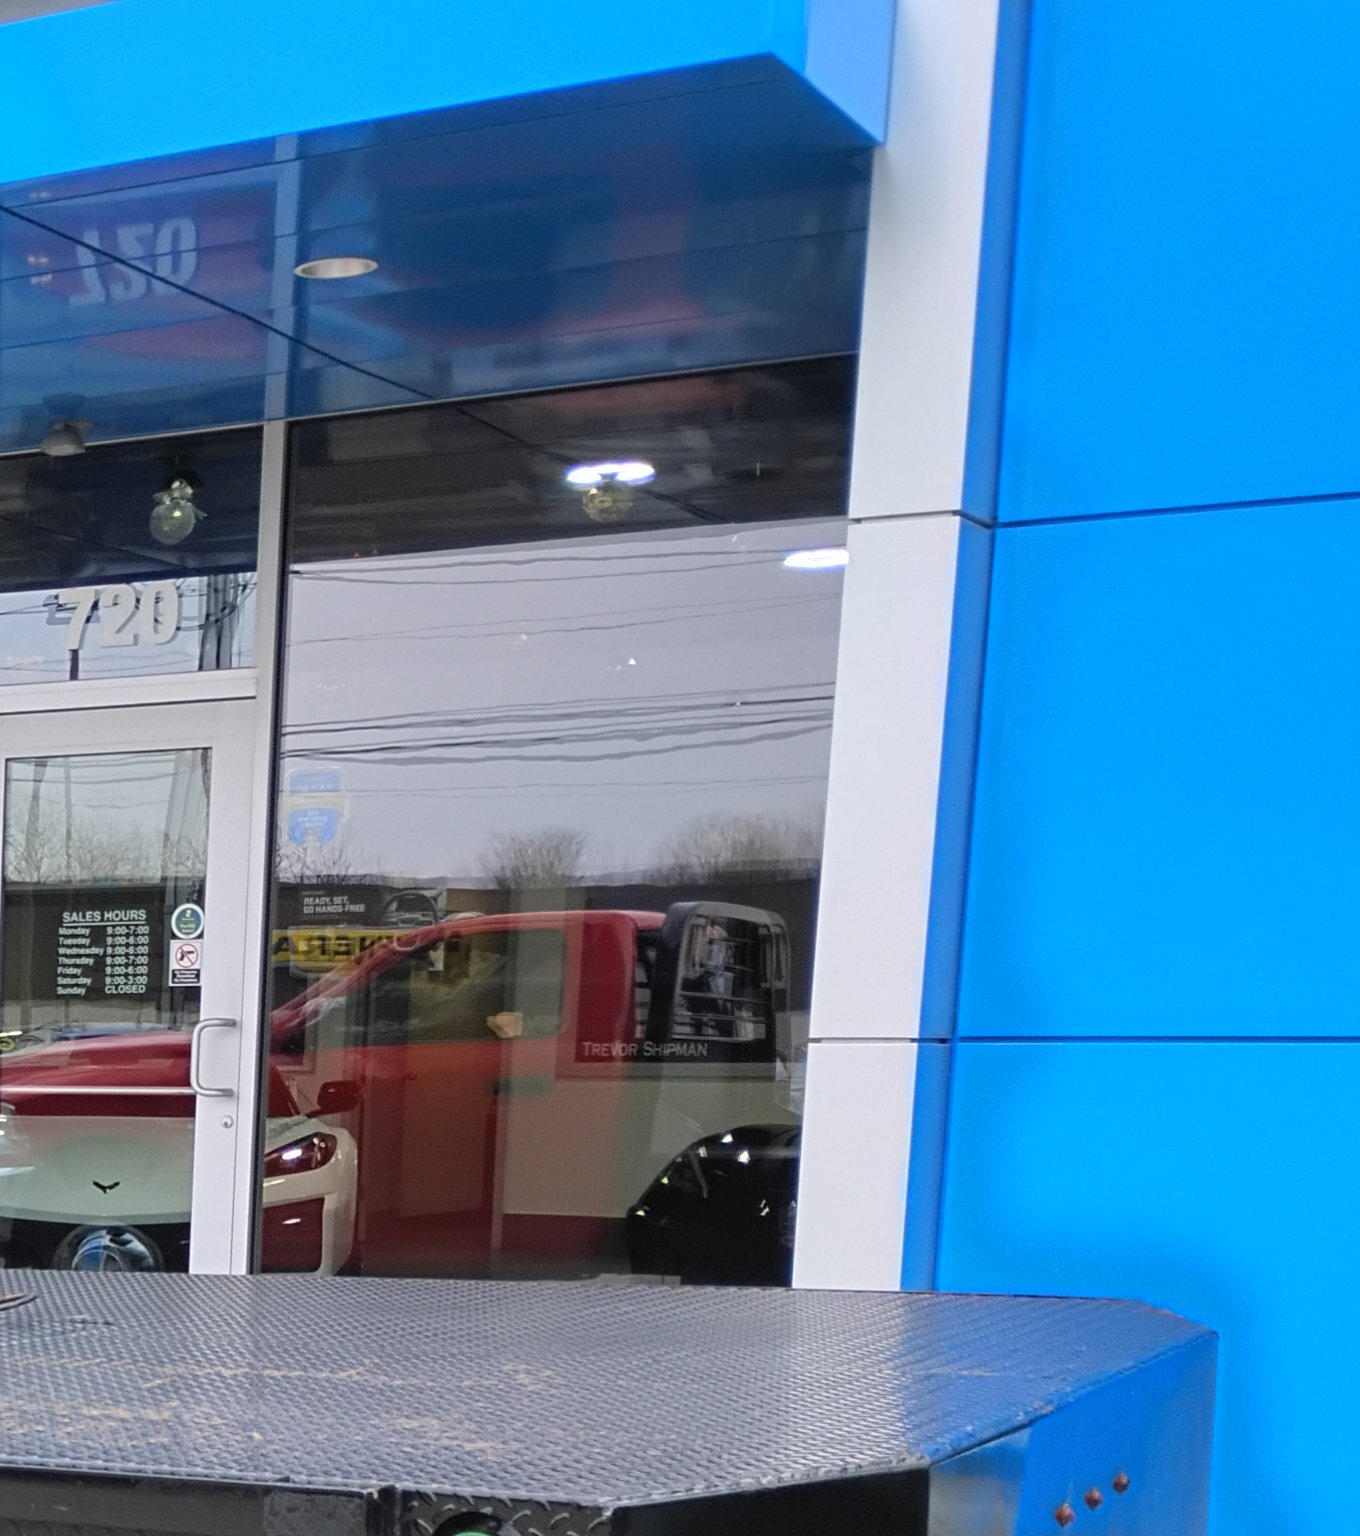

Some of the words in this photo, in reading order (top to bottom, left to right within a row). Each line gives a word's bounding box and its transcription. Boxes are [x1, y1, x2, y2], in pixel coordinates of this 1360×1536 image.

[57, 581, 179, 651] 720
[62, 911, 101, 923] SALES
[104, 909, 147, 922] HOURS
[58, 927, 90, 936] Monday
[106, 926, 149, 935] 9:00-7:00
[58, 937, 90, 946] Tuesday
[57, 947, 104, 956] Wednesday
[58, 957, 94, 966] Thursday
[105, 956, 149, 965] 9:00-7:00
[57, 967, 82, 976] Friday
[56, 976, 92, 986] Saturday
[56, 986, 86, 996] Sunday
[105, 985, 146, 994] CLOSED
[582, 1041, 638, 1057] TREVOR
[643, 1040, 708, 1057] SHIPMAN
